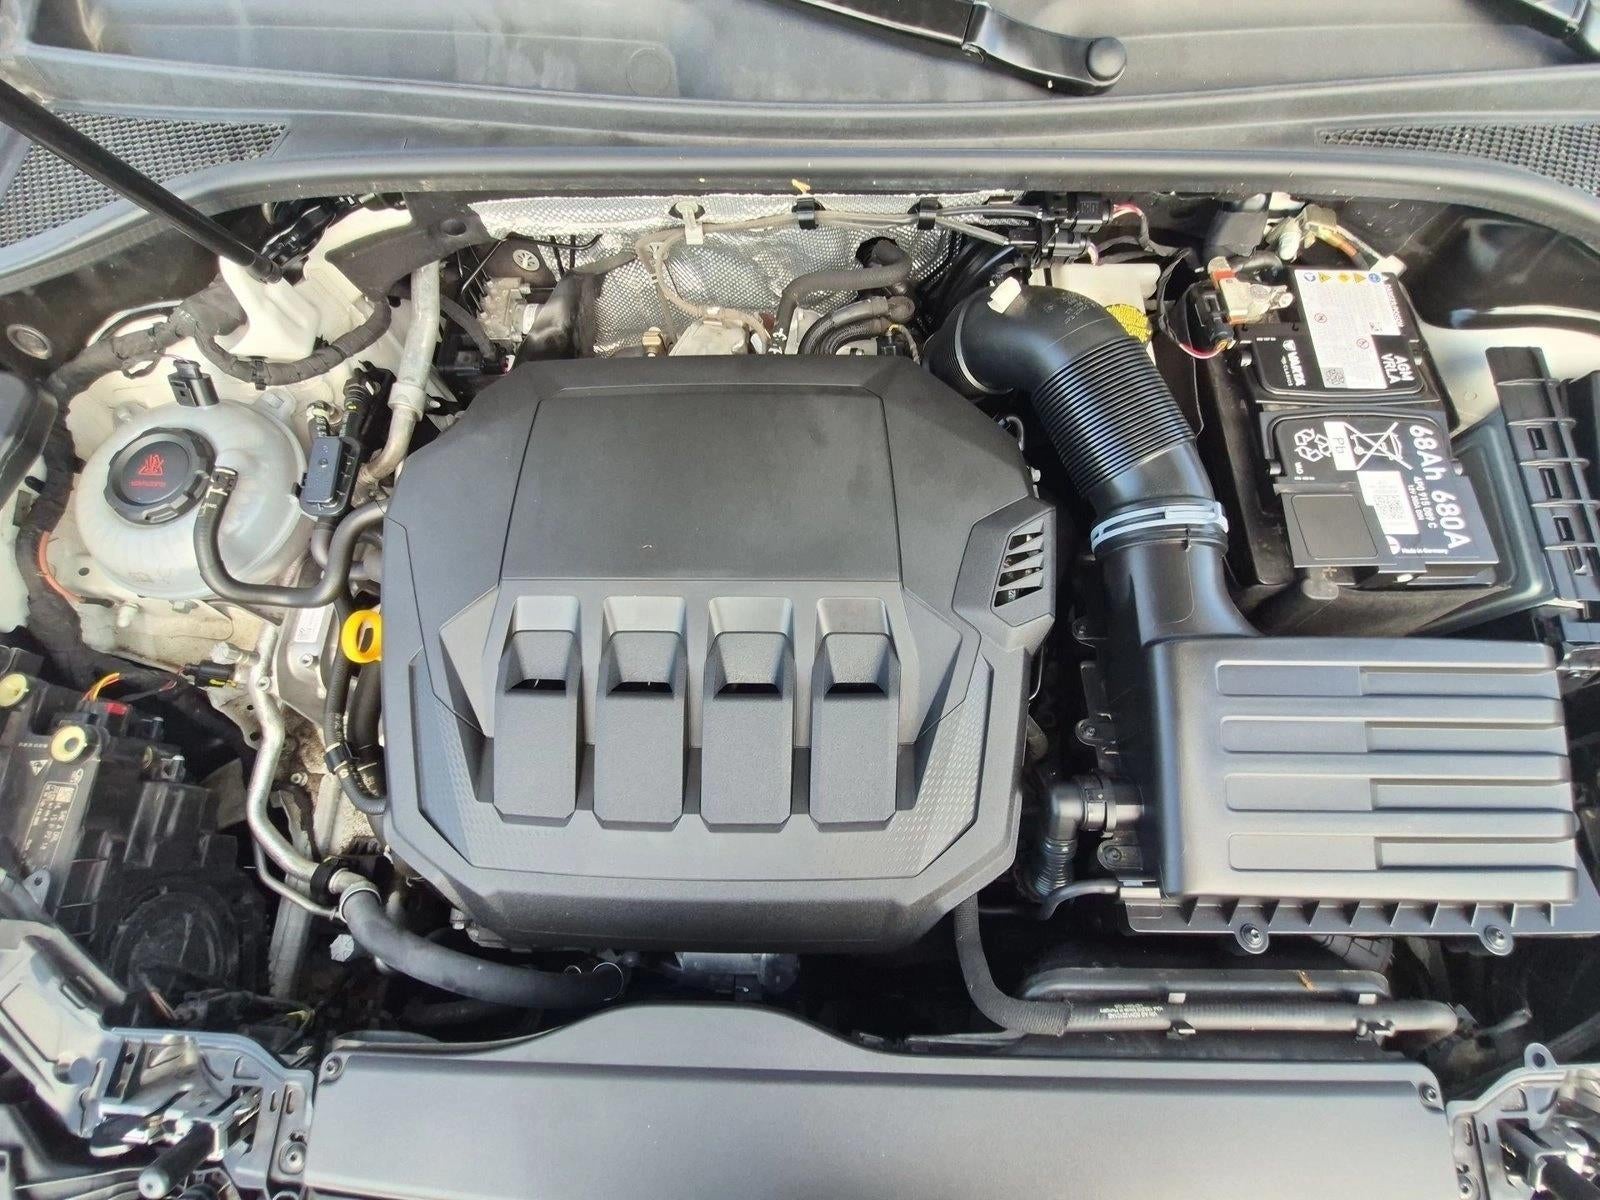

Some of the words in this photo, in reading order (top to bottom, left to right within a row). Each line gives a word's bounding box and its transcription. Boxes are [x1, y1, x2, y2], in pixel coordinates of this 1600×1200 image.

[1381, 353, 1401, 384] VRLA
[1393, 354, 1415, 381] AGM
[1409, 424, 1448, 481] 68Ah
[1431, 489, 1472, 549] 680A
[1423, 547, 1448, 555] Germany
